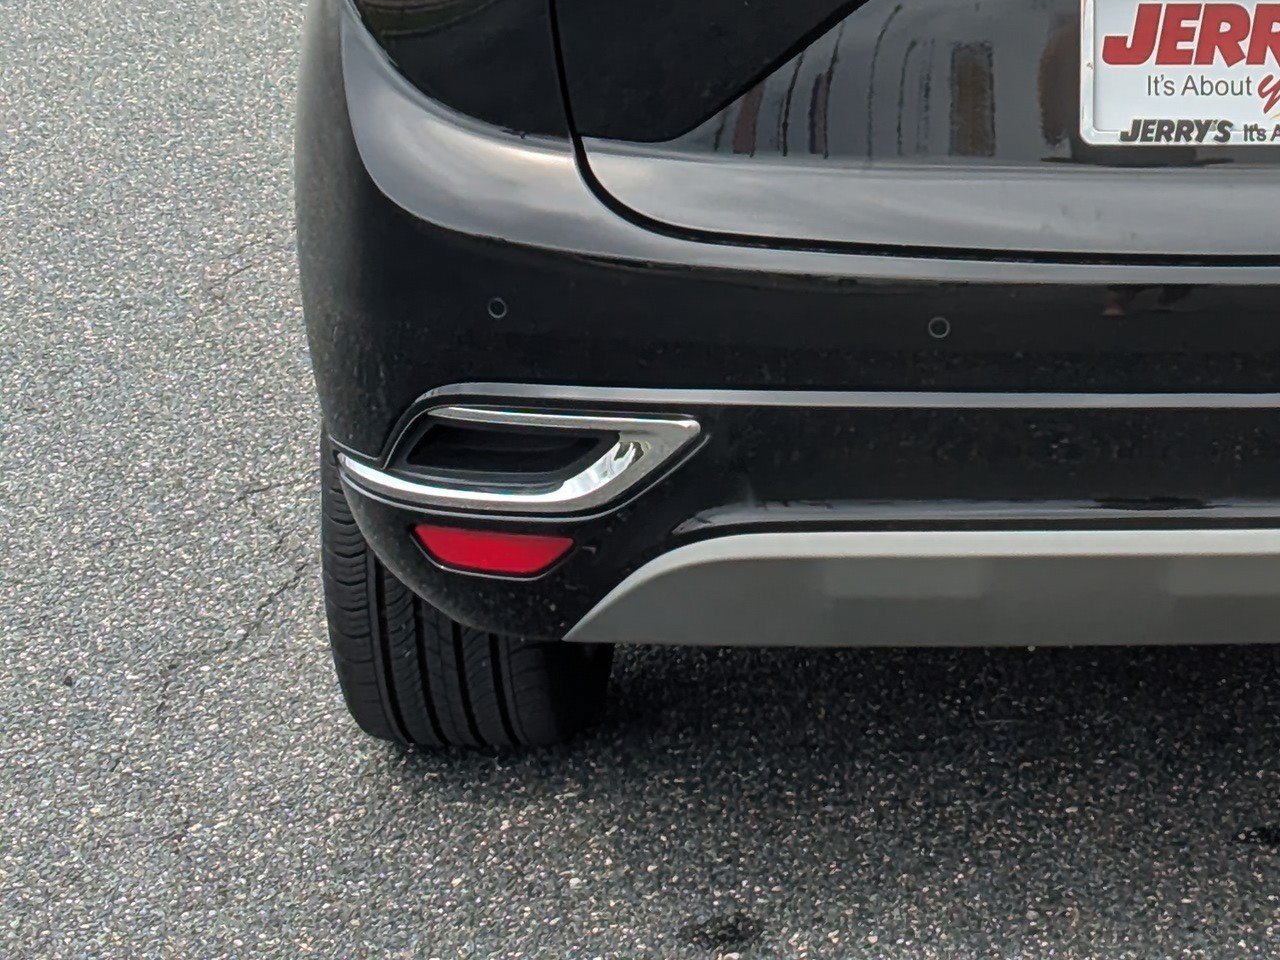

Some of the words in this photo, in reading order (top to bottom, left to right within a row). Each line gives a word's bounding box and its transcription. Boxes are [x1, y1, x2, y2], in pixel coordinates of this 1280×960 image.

[1147, 75, 1176, 96] It's
[1181, 75, 1253, 97] About
[1120, 119, 1234, 143] JERRY'S
[1243, 124, 1268, 142] It's
